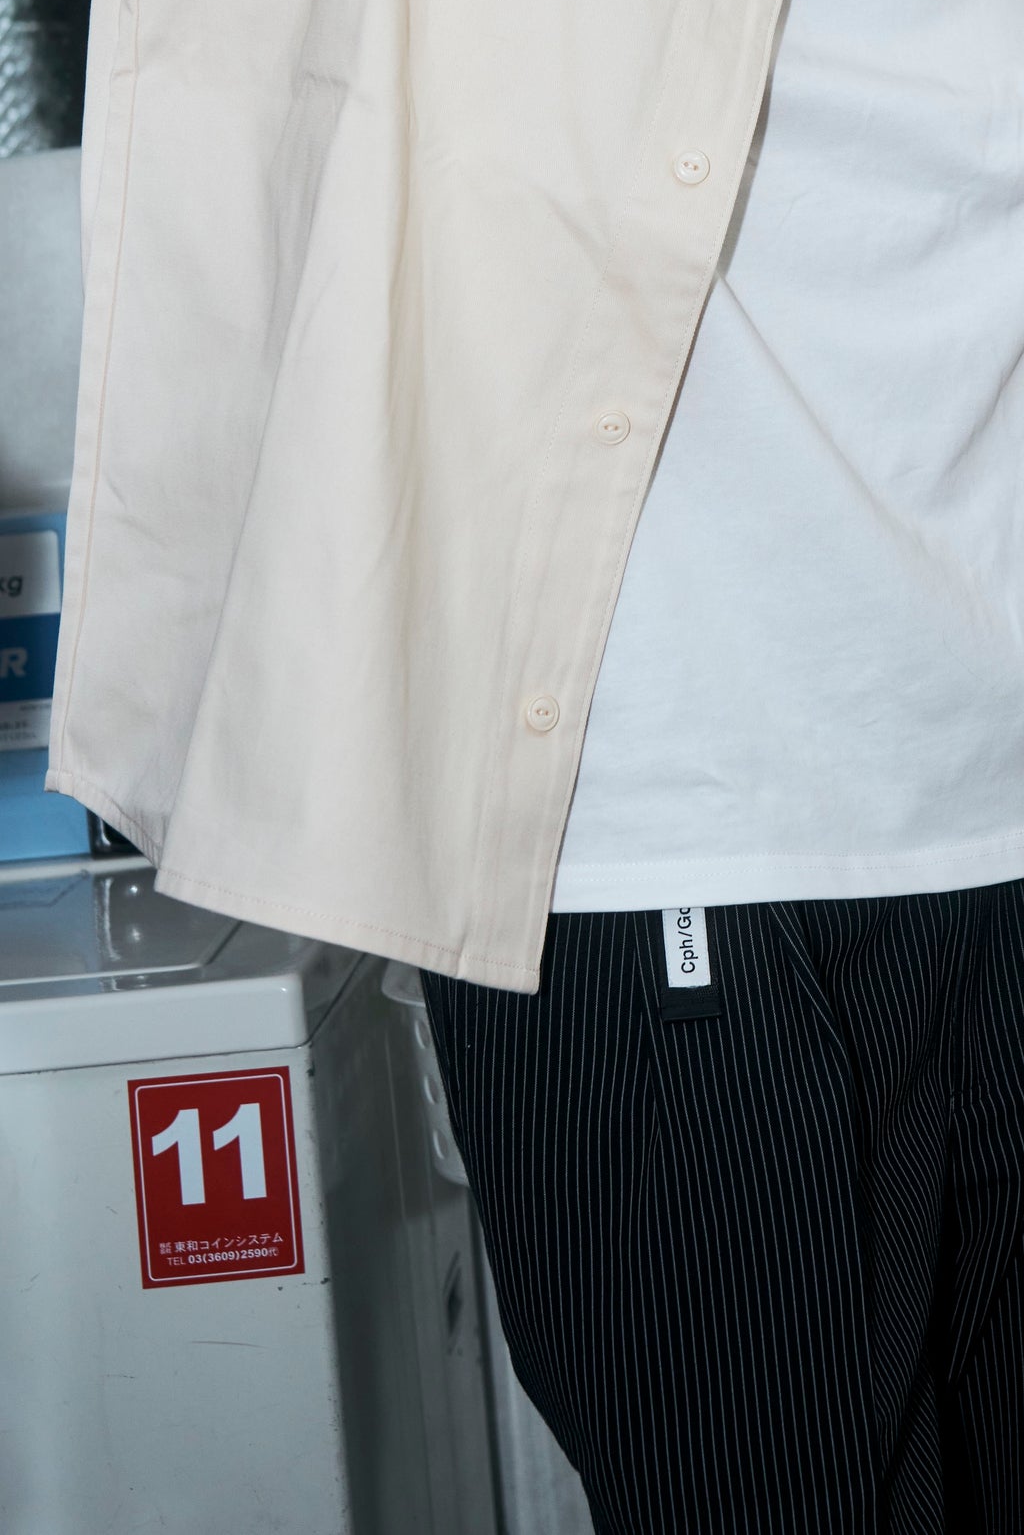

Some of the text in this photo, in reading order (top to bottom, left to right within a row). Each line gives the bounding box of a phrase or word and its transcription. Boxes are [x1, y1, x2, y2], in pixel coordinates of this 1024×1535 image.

[151, 1102, 267, 1206] 11
[174, 1232, 284, 1254] 東和コインシステム
[167, 1257, 186, 1266] TEL
